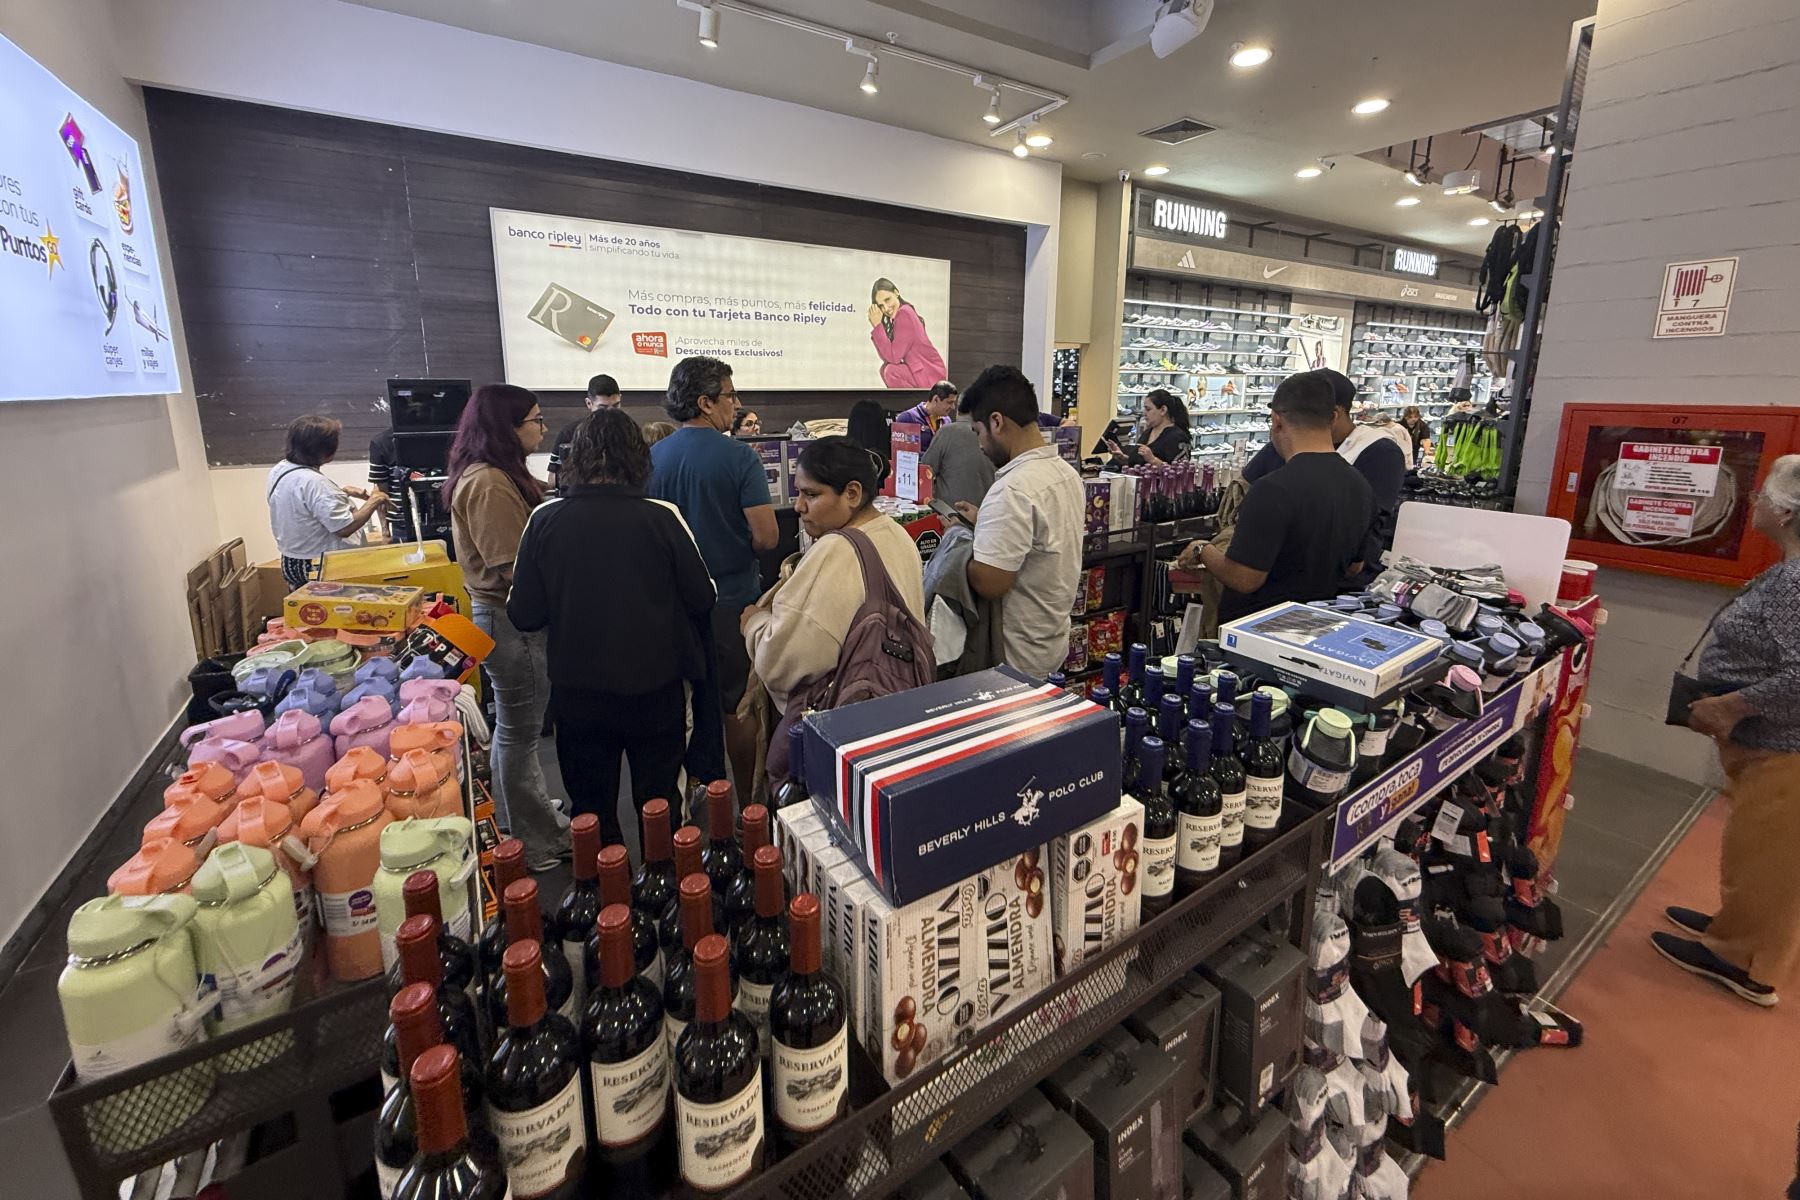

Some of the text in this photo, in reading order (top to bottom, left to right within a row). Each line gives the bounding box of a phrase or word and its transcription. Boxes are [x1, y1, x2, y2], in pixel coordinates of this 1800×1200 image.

[19, 204, 39, 226] tus
[1154, 199, 1227, 239] RUNNING
[0, 225, 58, 263] Puntos GO
[508, 226, 582, 246] banco ripley
[589, 234, 661, 249] Más de 20 años
[589, 245, 680, 260] simplificando tu vida
[1394, 249, 1437, 276] RUNNING
[531, 287, 572, 336] R
[628, 289, 857, 313] Más compras, más puntos, más felicidad.
[1692, 299, 1700, 308] 7
[629, 304, 827, 326] Todo con tu Tarjeta Banco Ripley
[1666, 313, 1718, 321] MANGUERA
[635, 333, 664, 343] ahora
[1665, 326, 1715, 334] INCENDIOS
[675, 347, 732, 357] Descuentos
[734, 348, 783, 357] Exclusivos!
[727, 338, 750, 347] miles
[752, 338, 762, 347] de
[1633, 445, 1710, 456] GABINETE CONTRA
[1648, 453, 1690, 463] INCENDIO
[1629, 498, 1692, 509] GABINETE CONTRA
[1643, 506, 1676, 514] INCENDIO
[1312, 642, 1377, 667] NAVIGATA
[1318, 667, 1367, 688] NAVIGATA
[918, 770, 1104, 857] BEVERLY HILLS POLO CLUB
[1380, 802, 1389, 821] y
[961, 882, 976, 929] Costa
[1009, 896, 1025, 990] ALMENDRA
[921, 916, 936, 1018] ALMENDRA
[976, 977, 989, 1021] Costa
[1260, 991, 1280, 1013] INDEX
[1165, 1030, 1188, 1052] INDEX
[779, 1037, 847, 1072] RESERVADO
[686, 1084, 760, 1128] RESERVADO
[1117, 1115, 1144, 1144] INDEX
[1247, 1161, 1266, 1186] INDEX
